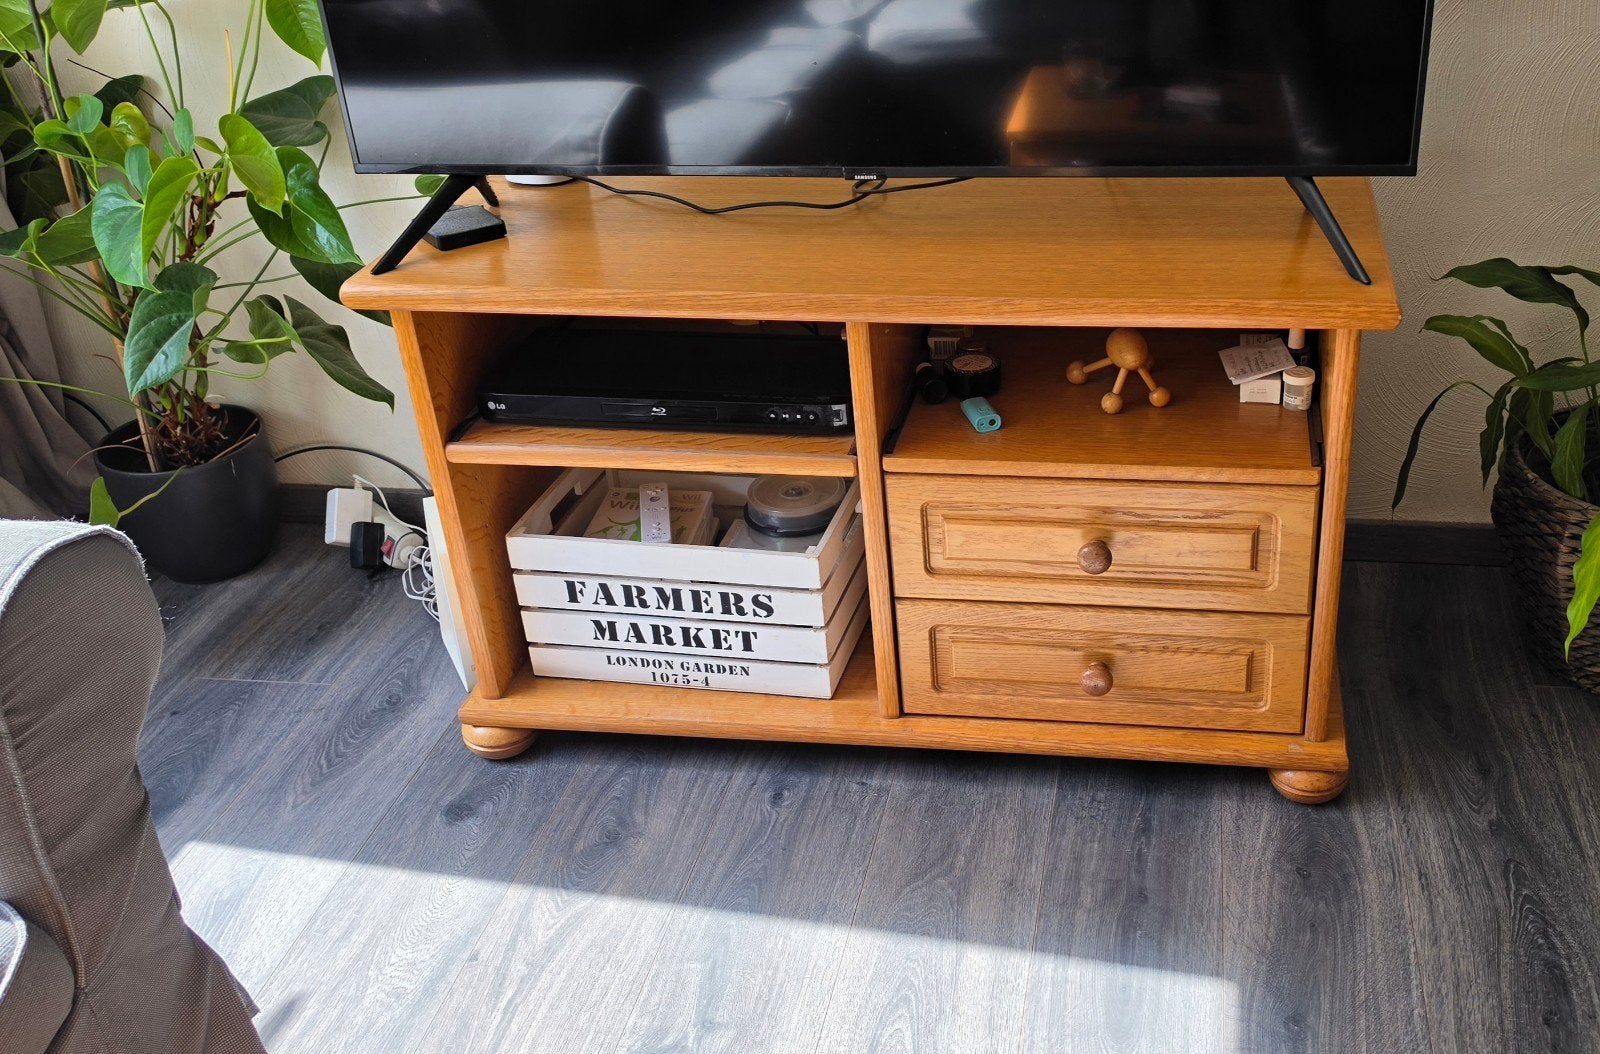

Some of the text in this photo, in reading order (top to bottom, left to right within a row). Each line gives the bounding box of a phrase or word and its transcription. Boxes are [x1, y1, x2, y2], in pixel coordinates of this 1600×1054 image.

[564, 580, 775, 618] FARMERS
[590, 619, 758, 652] MARKET
[606, 655, 750, 677] LONDON GARDEN
[650, 671, 710, 687] 1075-4
